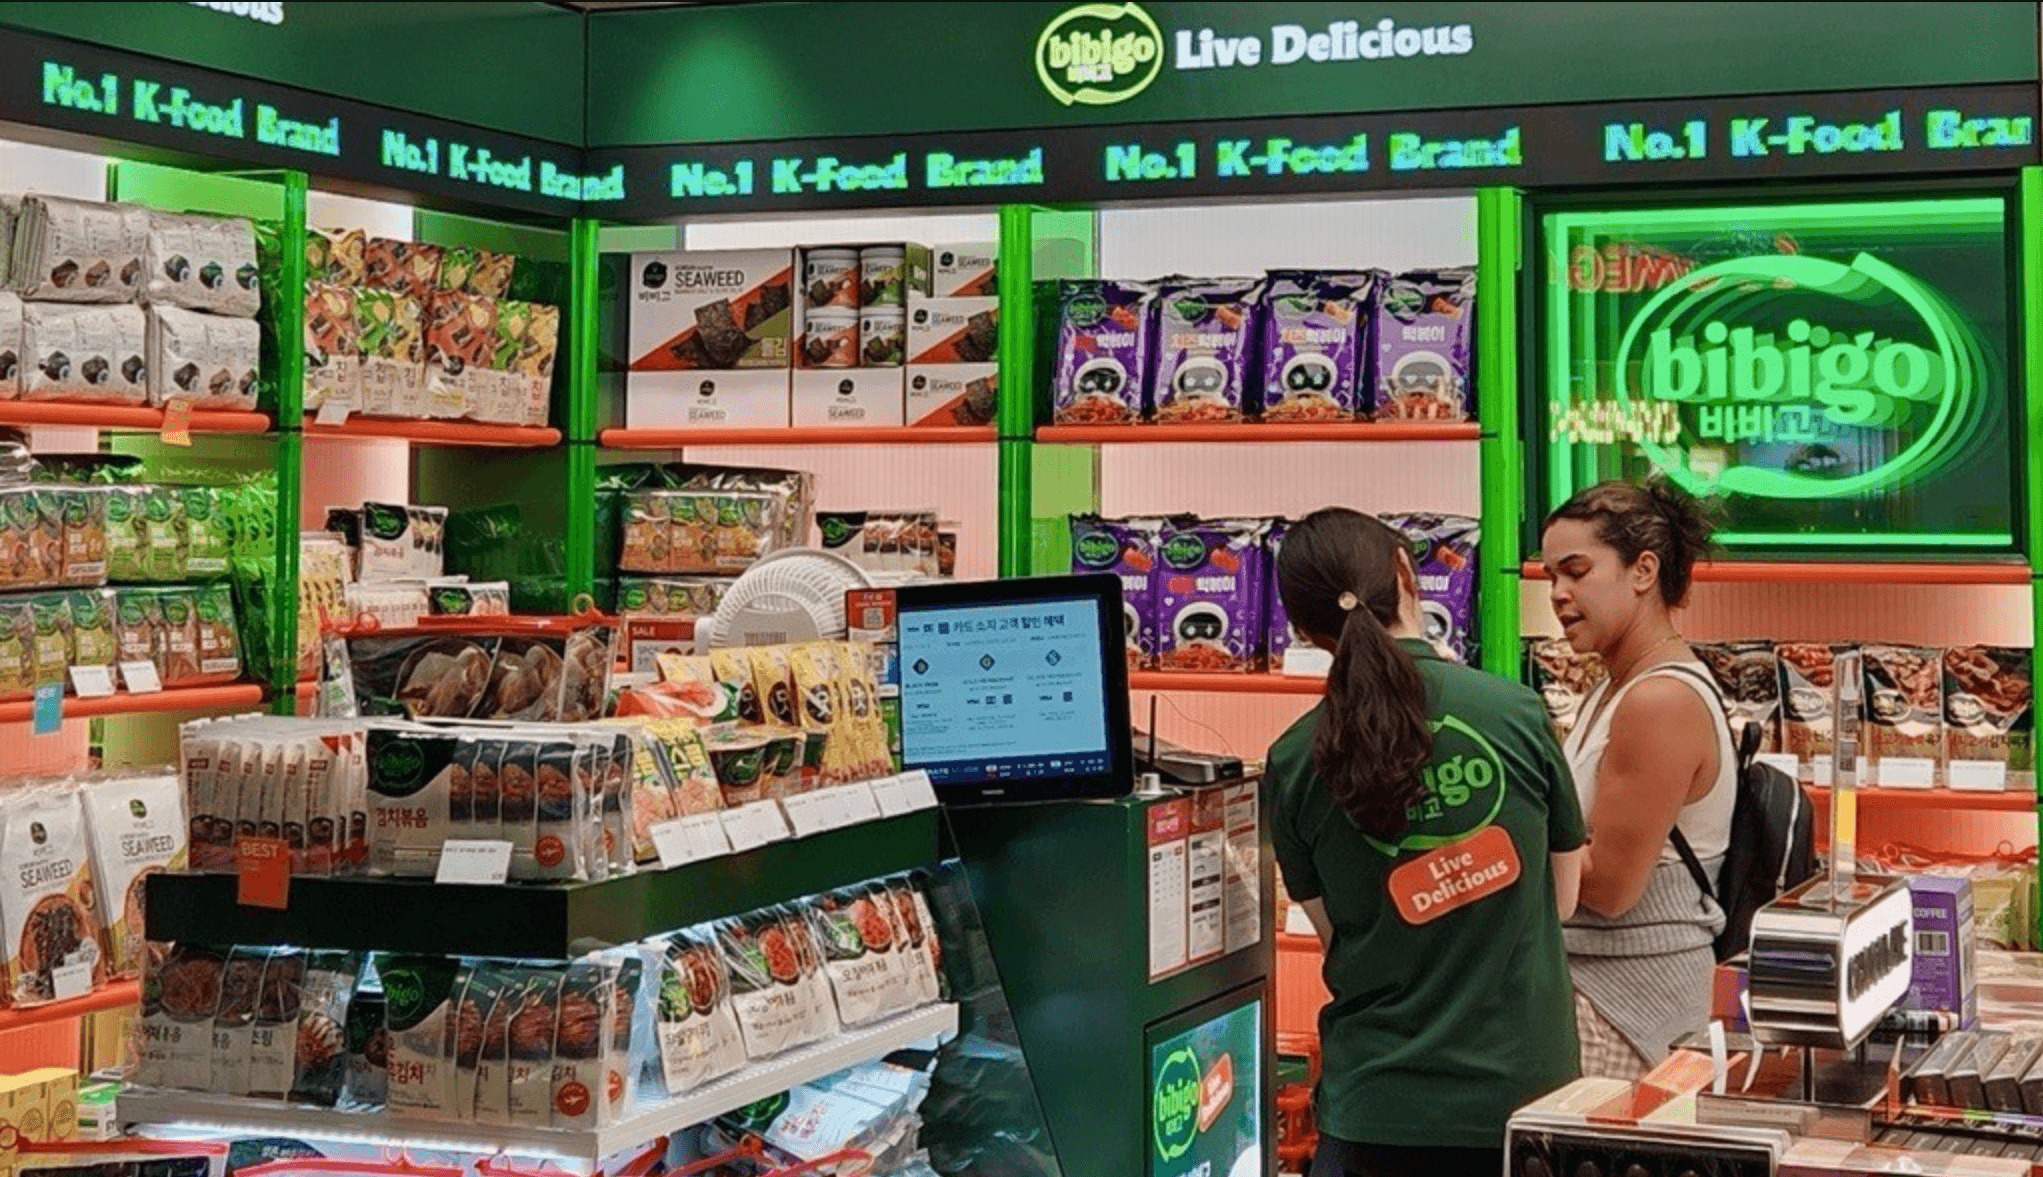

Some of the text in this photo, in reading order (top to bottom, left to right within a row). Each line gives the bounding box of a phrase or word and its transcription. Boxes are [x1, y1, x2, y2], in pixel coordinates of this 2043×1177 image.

[1049, 28, 1155, 75] bibigo
[1175, 19, 1473, 68] Live Delicious
[42, 62, 340, 156] No.1 K-Food Brand
[1105, 127, 1522, 181] No.1 K-Food Brand
[1603, 121, 1706, 162] No.1
[1730, 110, 1904, 157] K-Food
[382, 130, 625, 201] No.1 K-Food Brand
[671, 148, 1043, 197] No.1 K-Food Brand
[674, 270, 745, 288] SEAWEED
[1649, 319, 1931, 428] bibigo
[1699, 404, 1813, 442] 비비고
[121, 835, 175, 856] SEAWEED
[241, 841, 278, 859] BEST
[1428, 850, 1475, 881] Live
[20, 859, 73, 888] SEAWEED
[1411, 858, 1510, 913] Delicious
